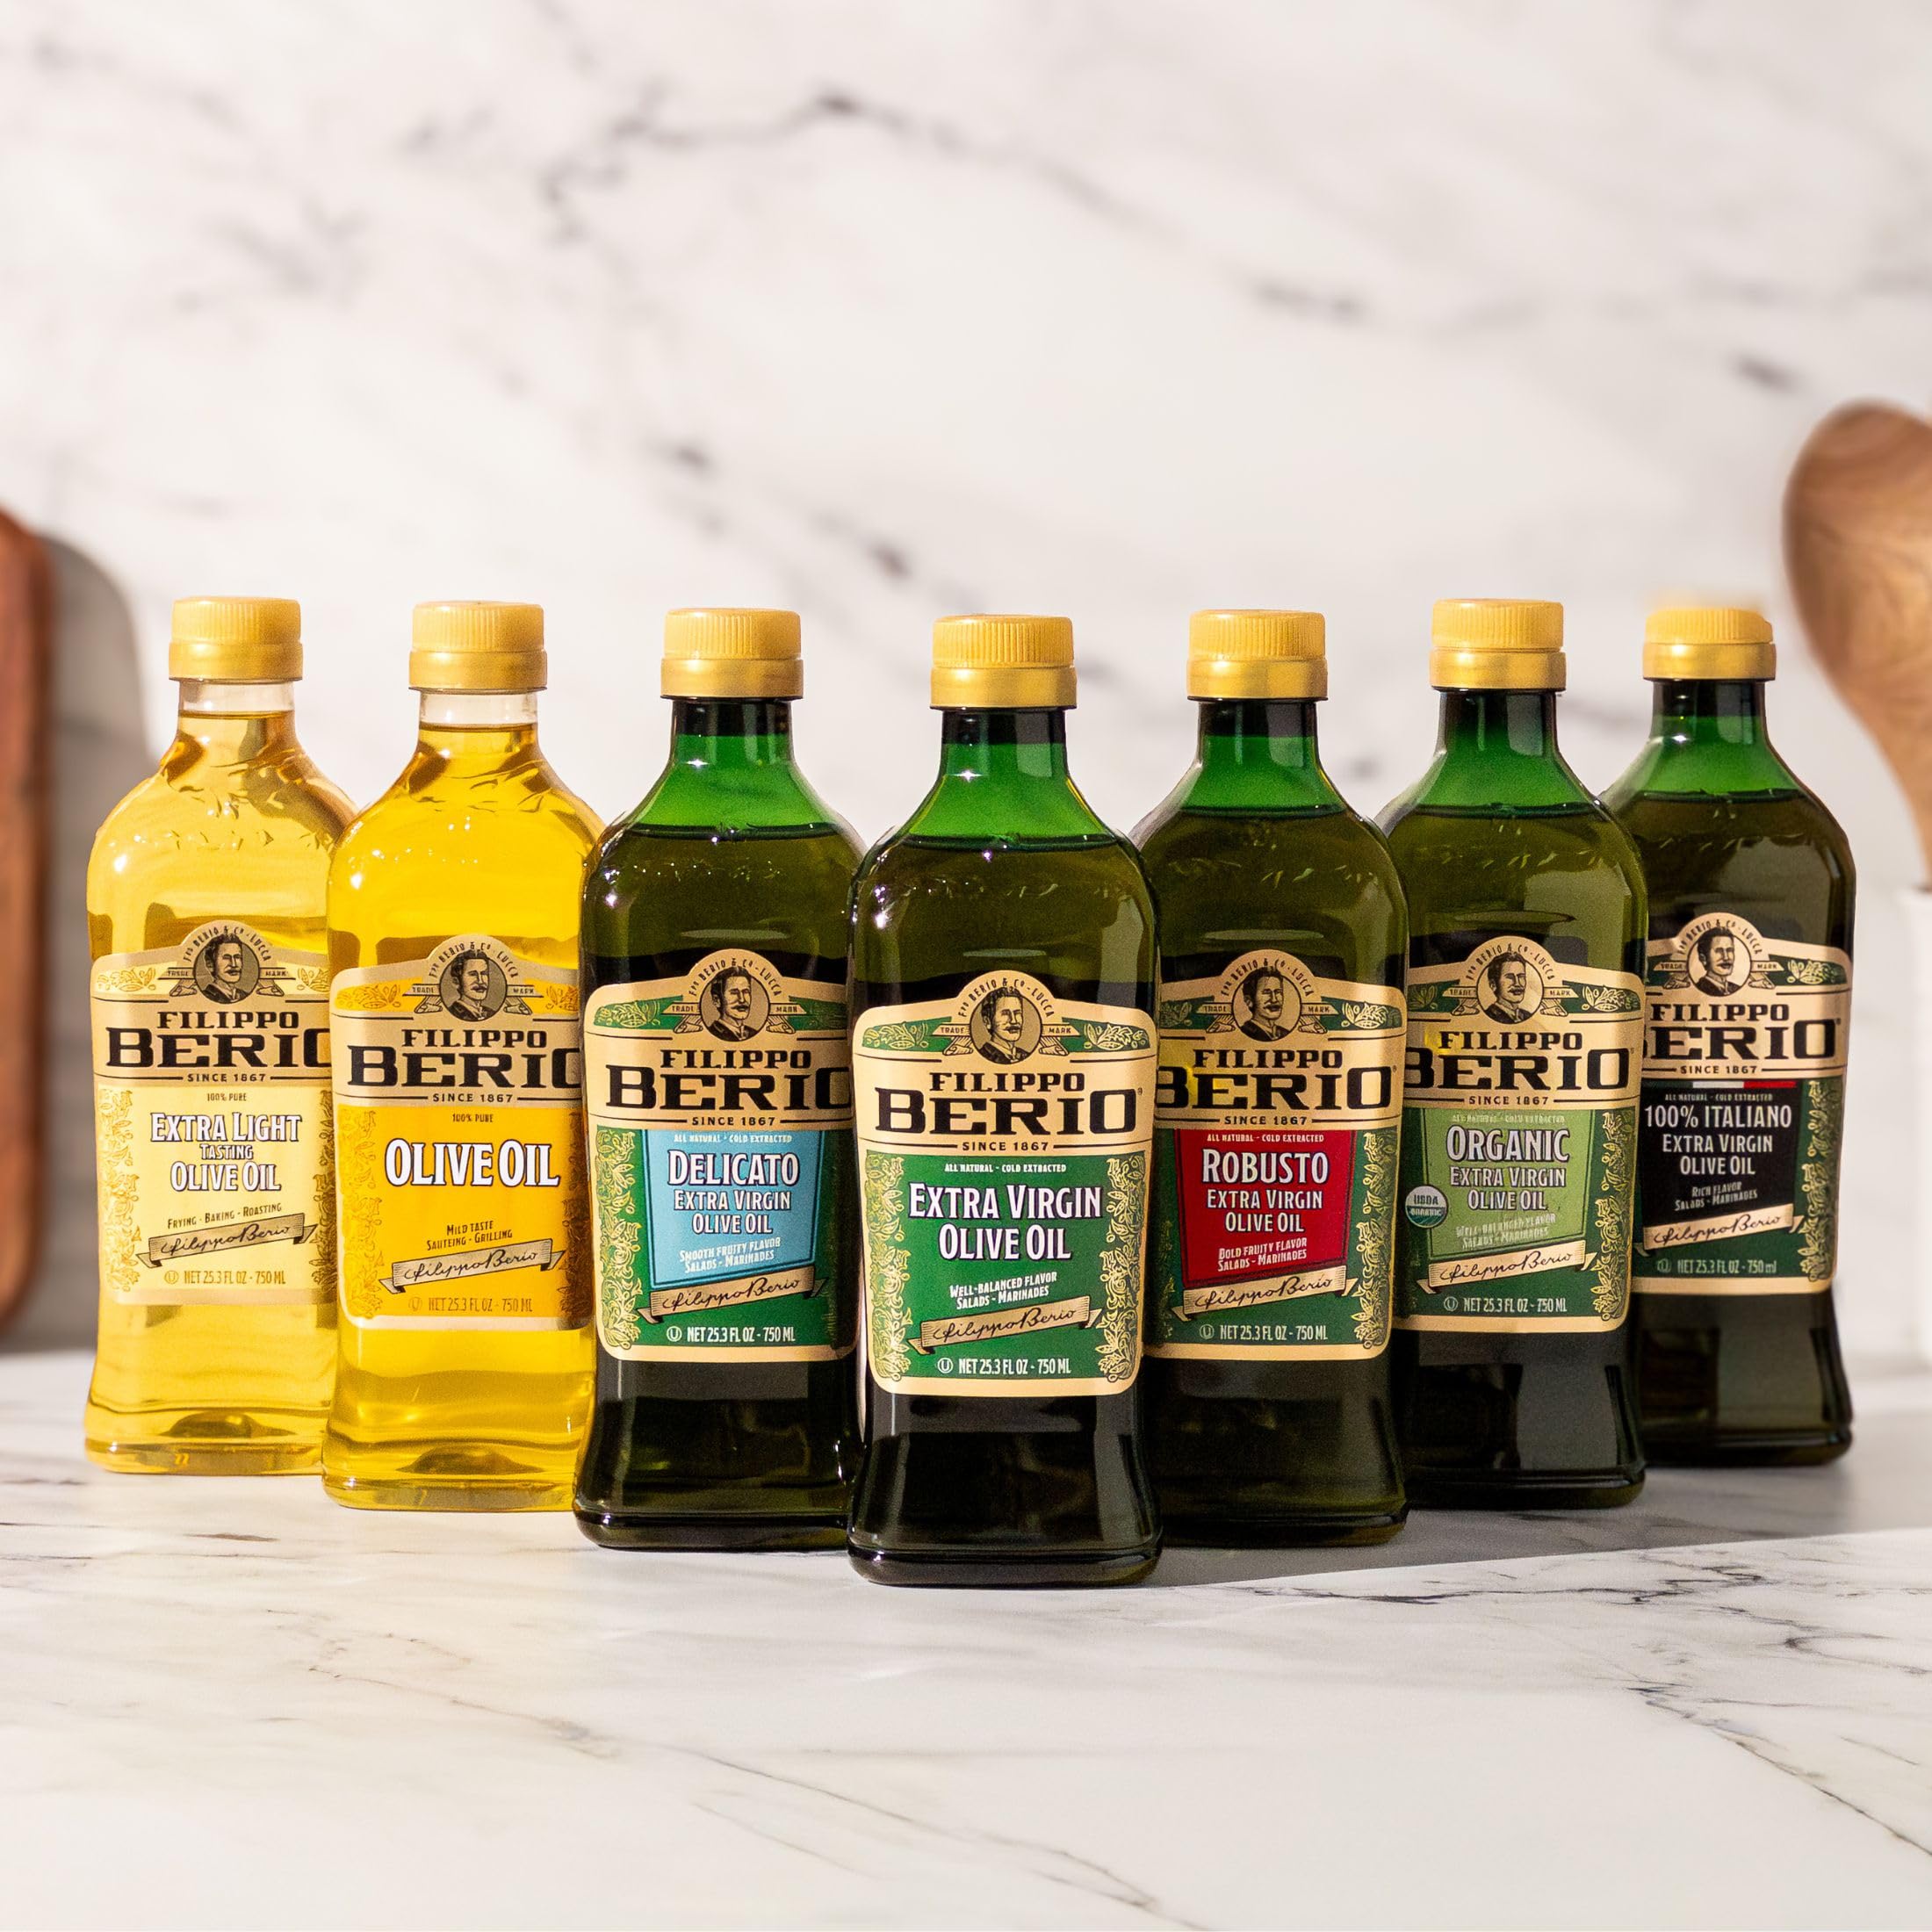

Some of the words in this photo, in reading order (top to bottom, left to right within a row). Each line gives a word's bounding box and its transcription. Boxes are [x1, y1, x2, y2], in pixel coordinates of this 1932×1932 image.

[157, 1012, 299, 1029] FILIPPO
[1650, 1004, 1789, 1021] FILIPPO
[401, 1029, 547, 1049] FILIPPO
[1438, 1031, 1582, 1049] FILIPPO
[1643, 1020, 1835, 1060] ERIO
[660, 1049, 811, 1070] FILIPPO
[1194, 1049, 1343, 1070] FILIPPO
[605, 1064, 851, 1110] BERIO
[929, 1072, 1085, 1092] FILIPPO
[433, 1093, 473, 1102] SINCE
[480, 1094, 513, 1103] 1867
[692, 1117, 734, 1126] SINCE
[741, 1117, 775, 1126] 1867
[875, 1087, 1137, 1135] BERIO
[1224, 1116, 1266, 1125] SINCE
[1645, 1105, 1698, 1128] 100%
[1705, 1105, 1791, 1128] ITALIANO
[151, 1113, 226, 1143] EXTRA
[231, 1113, 302, 1143] LIGHT
[200, 1143, 253, 1160] TASTING
[962, 1142, 1006, 1151] SINCE
[1013, 1142, 1049, 1151] 1867
[1446, 1124, 1570, 1162] ORGANIC
[1662, 1134, 1714, 1152] EXTRA
[1718, 1134, 1773, 1152] VIRGIN
[385, 1138, 494, 1187] OLIVE
[498, 1138, 560, 1187] OIL
[667, 1150, 799, 1188] DELICATO
[961, 1164, 993, 1172] NATURAL
[1201, 1149, 1330, 1185] ROBUSTO
[1680, 1156, 1726, 1175] OLIVE
[1730, 1156, 1755, 1175] OIL
[170, 1162, 238, 1192] OLIVE
[242, 1162, 281, 1192] OIL
[1450, 1165, 1503, 1186] EXTRA
[1509, 1166, 1566, 1186] VIRGIN
[1207, 1188, 1259, 1210] EXTRA
[1265, 1188, 1323, 1210] VIRGIN
[1414, 1195, 1438, 1205] USDA
[1467, 1190, 1517, 1210] OLIVE
[1520, 1190, 1547, 1210] OIL
[1675, 1200, 1705, 1211] SALADS
[1712, 1189, 1757, 1205] MARINADES
[1691, 1186, 1711, 1198] RICH
[1713, 1181, 1742, 1194] FLAVOR
[674, 1190, 729, 1211] EXTRA
[733, 1190, 790, 1211] VIRGIN
[909, 1182, 999, 1219] EXTRA
[1007, 1184, 1103, 1220] VIRGIN
[168, 1216, 197, 1229] FRYING
[205, 1211, 234, 1222] BAKING
[243, 1203, 282, 1217] ROASTING
[692, 1213, 742, 1235] OLIVE
[746, 1213, 773, 1235] OIL
[1225, 1212, 1272, 1234] OLIVE
[1277, 1212, 1304, 1234] OIL
[447, 1224, 468, 1236] MILD
[471, 1221, 494, 1232] TASTE
[475, 1229, 512, 1244] GRILLING
[680, 1250, 714, 1262] SMOOTH
[717, 1244, 748, 1257] FRUITY
[749, 1237, 781, 1251] FLAVOR
[938, 1224, 1020, 1261] OLIVE
[1026, 1224, 1071, 1261] OIL
[1219, 1247, 1241, 1259] BOLD
[1244, 1243, 1273, 1256] FRUITY
[1276, 1237, 1307, 1251] FLAVOR
[685, 1259, 717, 1273] SALADS
[725, 1250, 775, 1267] MARINADES
[1218, 1258, 1250, 1272] SALADS
[1258, 1250, 1307, 1266] MARINADES
[1677, 1260, 1693, 1273] NET
[1717, 1260, 1727, 1273] FL
[1728, 1260, 1739, 1273] OZ
[1748, 1260, 1764, 1273] 750
[184, 1271, 201, 1284] NET
[224, 1271, 233, 1284] FL
[236, 1271, 247, 1284] OZ
[256, 1271, 271, 1284] 750
[949, 1278, 1022, 1298] WELL-BALANCED
[1025, 1272, 1057, 1287] FLAVOR
[956, 1295, 989, 1309] SALADS
[998, 1286, 1049, 1304] MARINADES
[1463, 1298, 1481, 1312] NET
[1483, 1298, 1503, 1312] 25.3
[1505, 1298, 1516, 1312] FL
[1517, 1298, 1528, 1312] OZ
[1538, 1298, 1553, 1313] 750
[1555, 1298, 1567, 1312] ML
[688, 1327, 706, 1341] NET
[708, 1327, 727, 1341] 25.3
[730, 1327, 740, 1341] FL
[744, 1327, 754, 1341] OZ
[764, 1327, 781, 1341] 750
[782, 1327, 795, 1341] ML
[1221, 1325, 1238, 1339] NET
[1240, 1325, 1260, 1340] 25.3
[1263, 1325, 1272, 1340] FL
[1275, 1325, 1287, 1340] OZ
[1296, 1325, 1314, 1340] 750
[1316, 1325, 1328, 1340] ML
[959, 1359, 978, 1373] NET
[979, 1359, 1000, 1373] 25.3
[1003, 1359, 1014, 1373] FL
[1016, 1359, 1027, 1373] OZ
[1037, 1359, 1056, 1373] 750
[1058, 1359, 1071, 1373] ML
